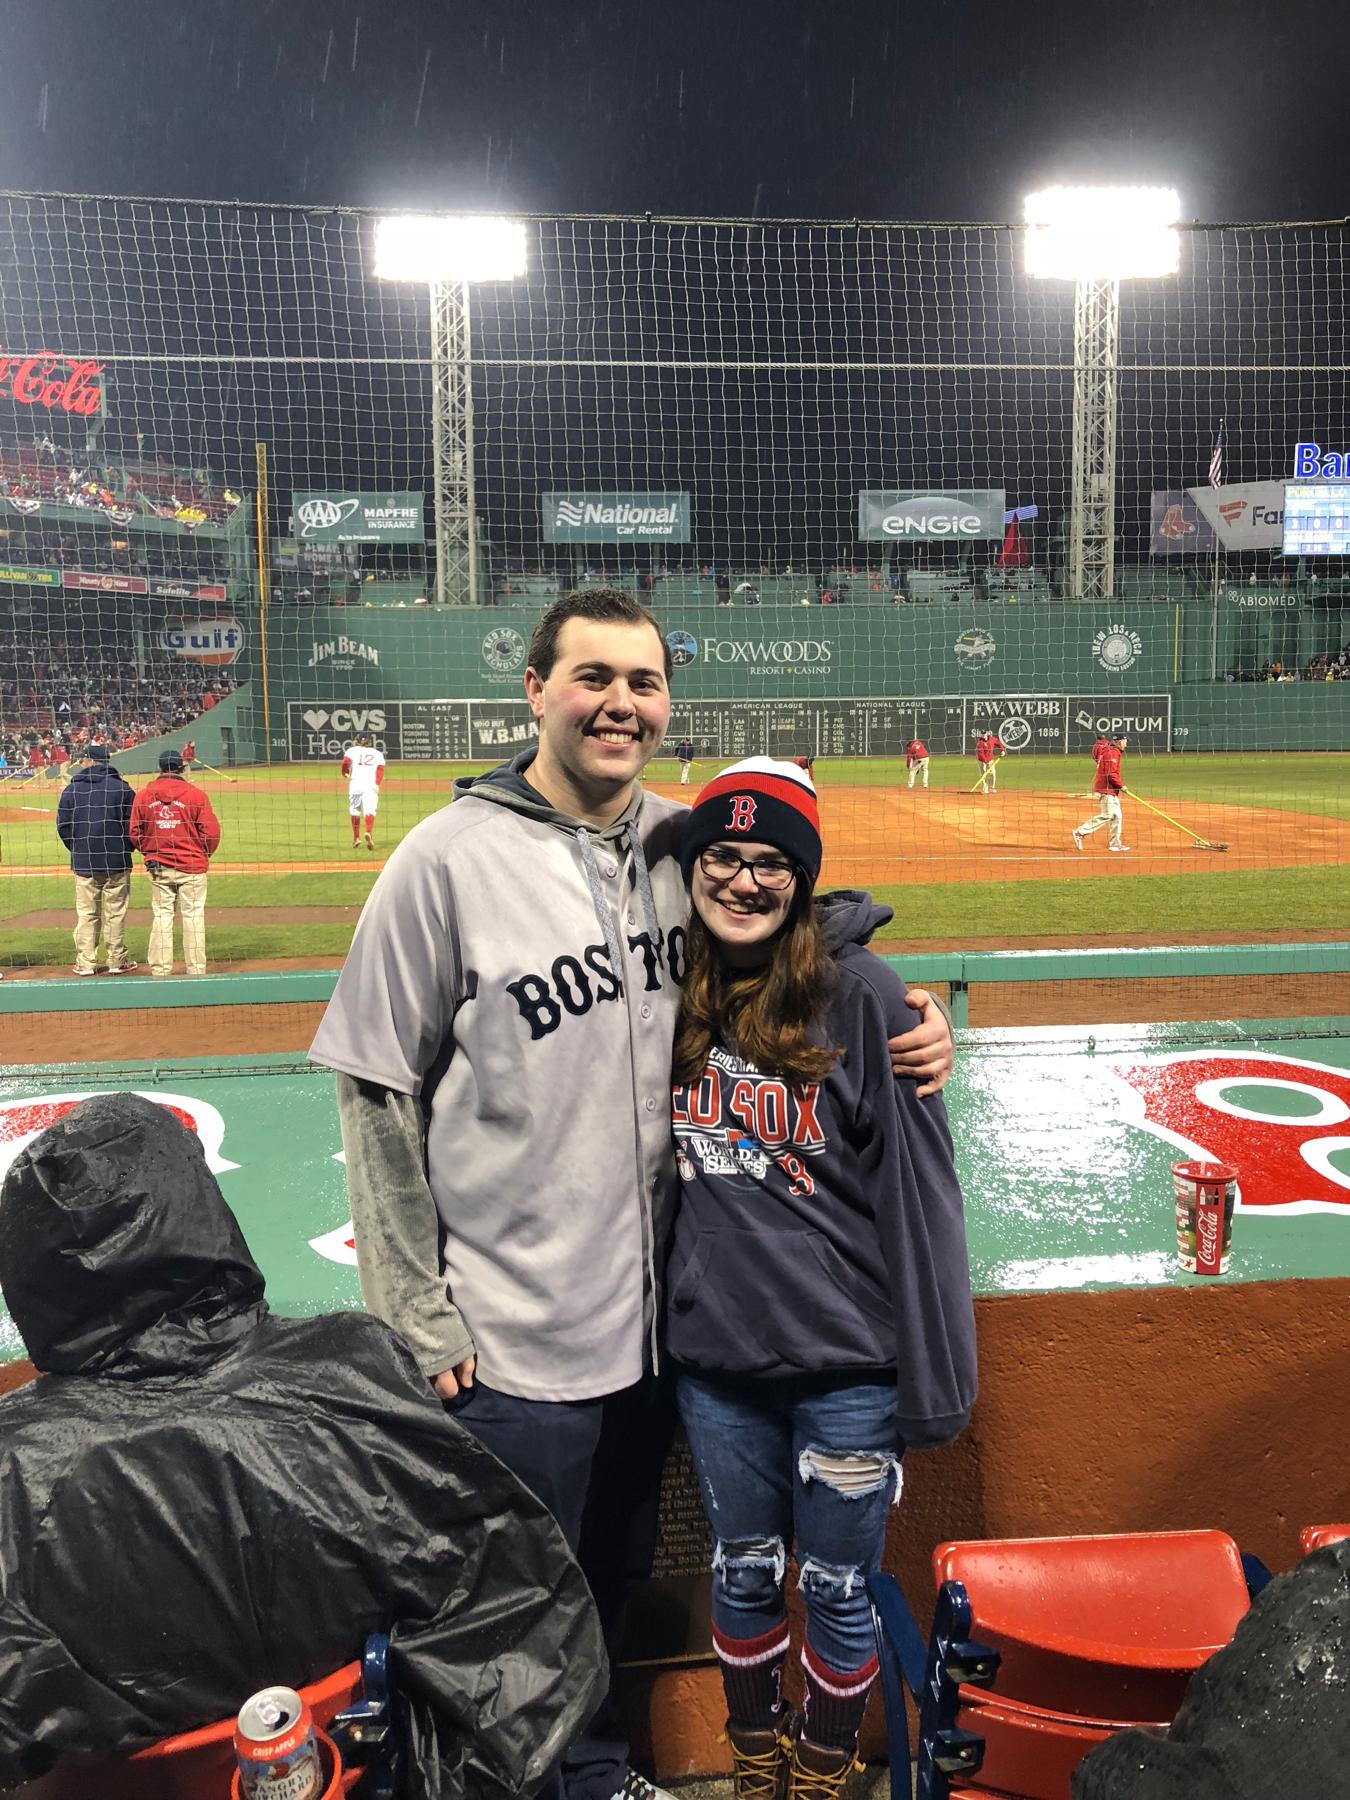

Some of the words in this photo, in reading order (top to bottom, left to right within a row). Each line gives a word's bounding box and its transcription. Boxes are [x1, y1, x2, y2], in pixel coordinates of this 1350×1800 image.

[1294, 442, 1350, 479] Ba
[303, 501, 337, 528] AAA
[364, 508, 418, 518] MAPFRE
[584, 503, 676, 524] National
[1252, 506, 1284, 527] Fa
[368, 521, 416, 529] INSURANCE
[616, 526, 635, 535] Car
[638, 526, 672, 535] Rental
[1239, 596, 1296, 606] ABIOMED
[164, 627, 238, 648] Gulf
[308, 642, 335, 667] JIM
[338, 636, 379, 666] BEAM
[703, 638, 831, 662] FOXWOODS
[750, 667, 784, 675] RESORT
[794, 667, 831, 675] CASINO
[972, 701, 1006, 716] F.W.
[1007, 701, 1060, 716] WEBB
[331, 710, 387, 731] CVS
[1096, 718, 1162, 732] OPTUM
[1038, 728, 1060, 737] 1866
[358, 755, 375, 766] 12
[725, 795, 758, 832] B
[730, 1079, 826, 1145] SOX
[704, 1156, 766, 1174] SERES
[253, 1747, 273, 1757] CRISP
